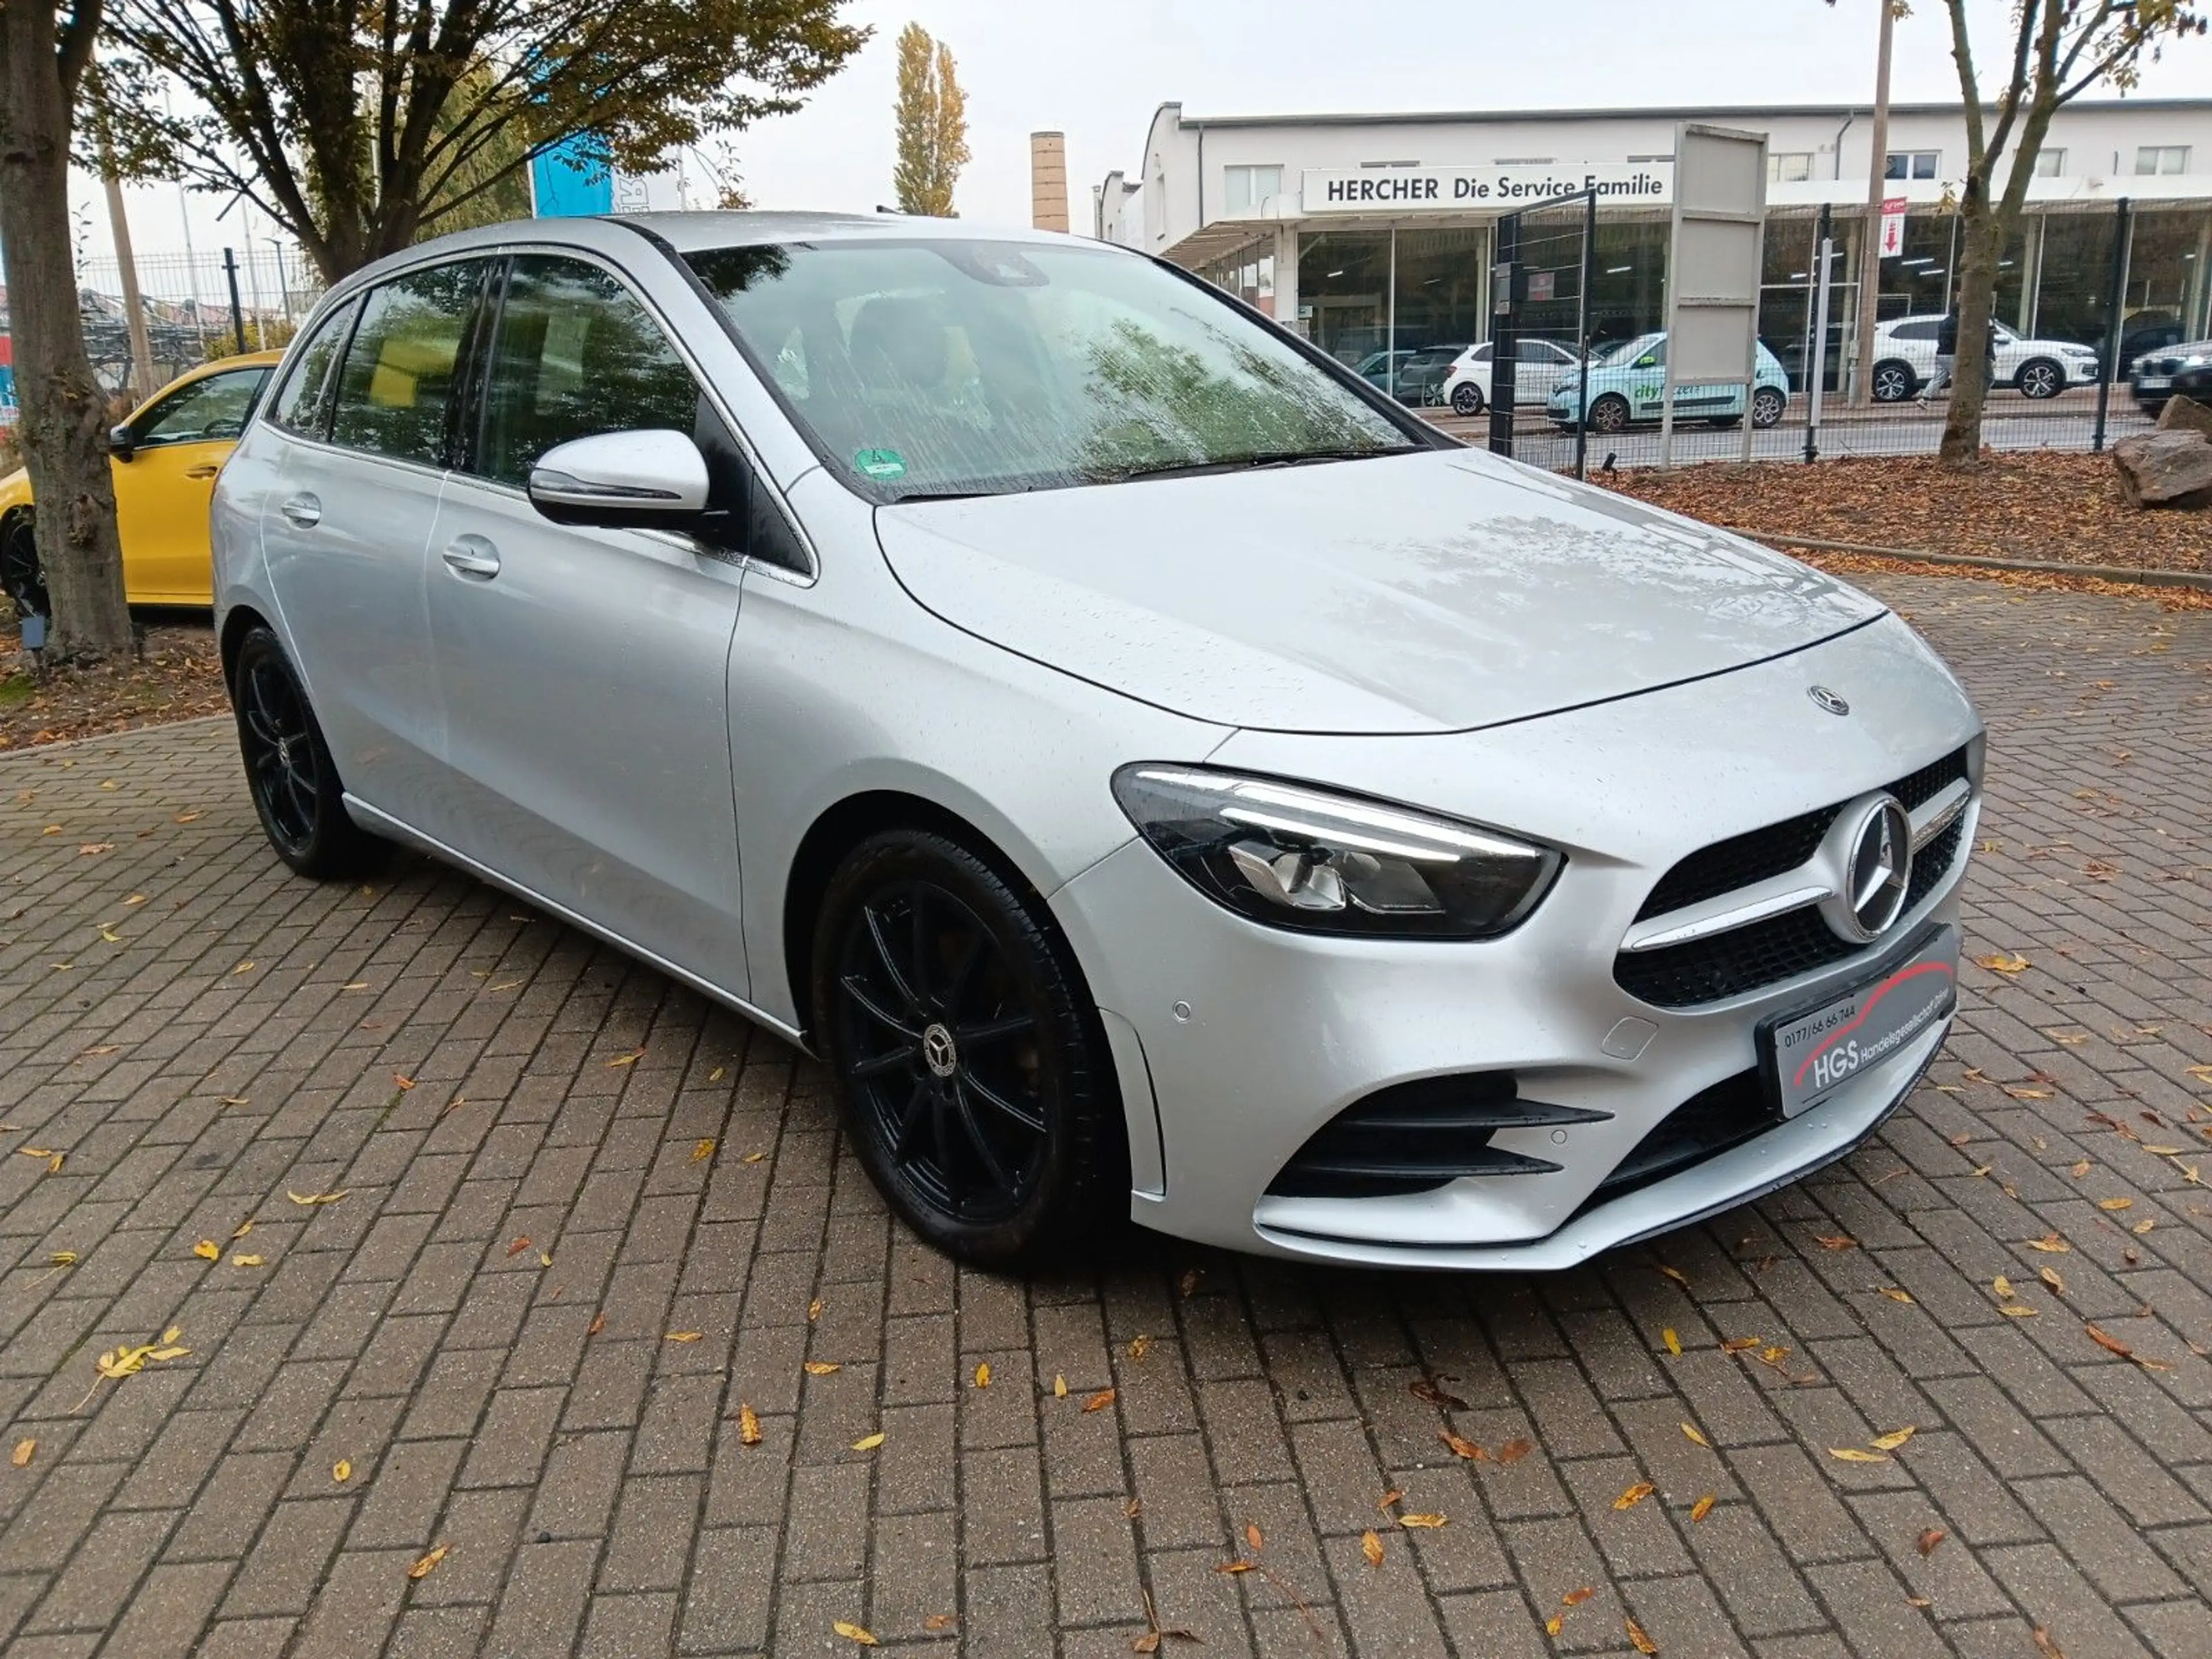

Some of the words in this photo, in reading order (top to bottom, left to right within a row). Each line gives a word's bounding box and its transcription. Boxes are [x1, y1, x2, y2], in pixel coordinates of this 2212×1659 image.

[1328, 178, 1439, 201] HERCHER
[1454, 177, 1490, 199] Die
[1497, 176, 1575, 198] Service
[1584, 173, 1663, 195] Familie
[1826, 1013, 1838, 1028] 66
[1813, 1040, 1859, 1088] HGS
